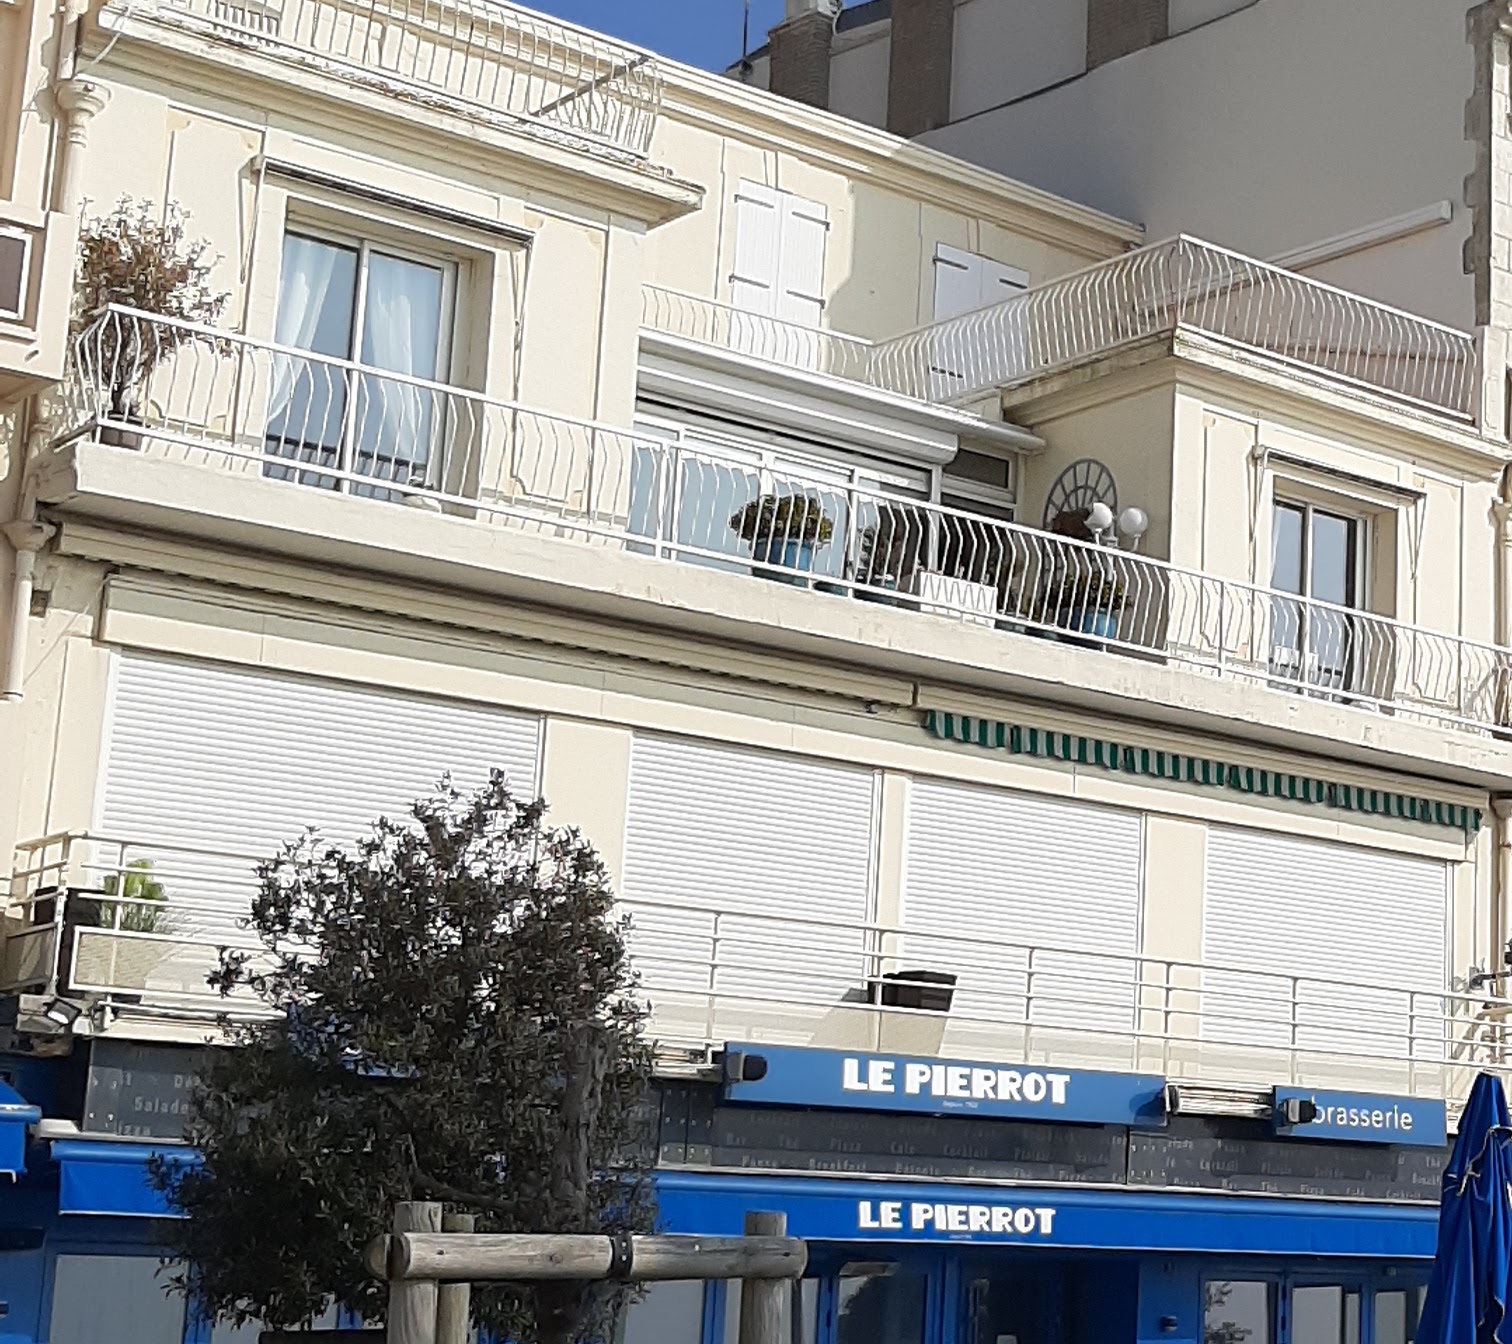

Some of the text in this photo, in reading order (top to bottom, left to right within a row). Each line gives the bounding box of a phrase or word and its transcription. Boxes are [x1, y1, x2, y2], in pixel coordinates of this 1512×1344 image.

[843, 1057, 1071, 1105] LE PIERROT
[1311, 1094, 1413, 1131] brasserie
[859, 1201, 1057, 1234] LE PIERROT
